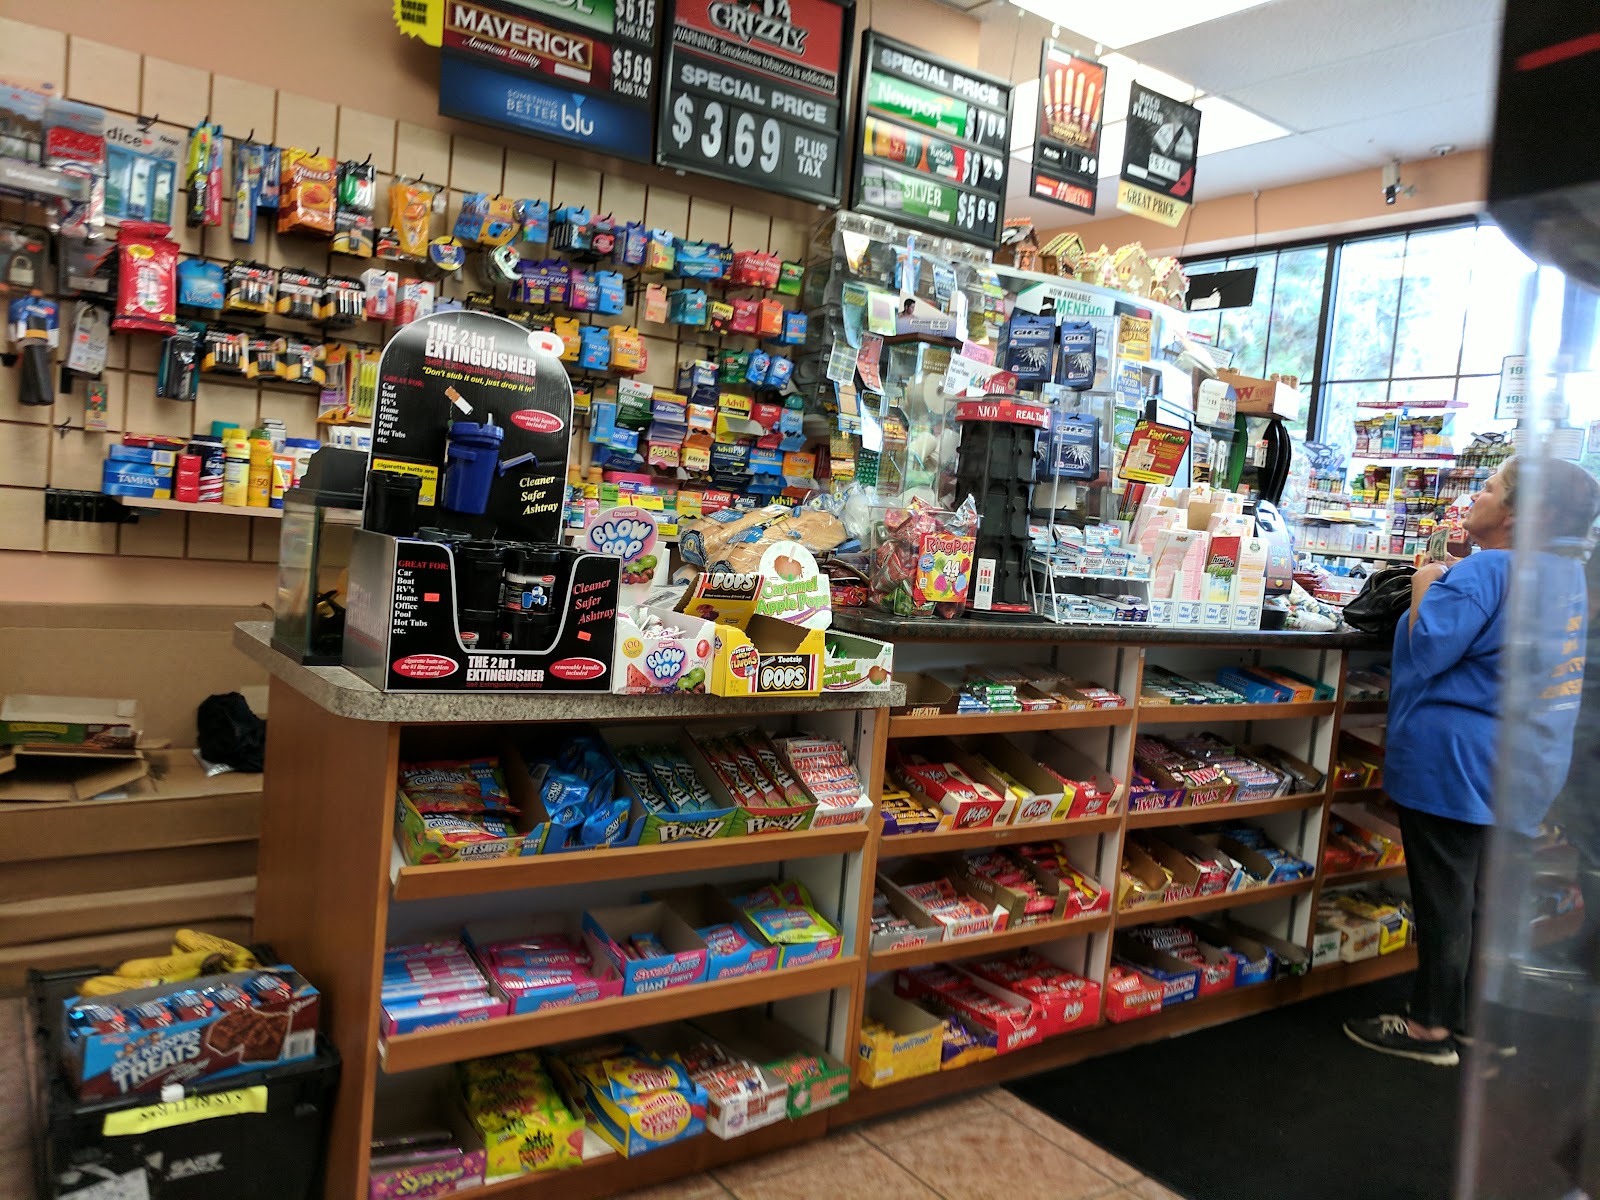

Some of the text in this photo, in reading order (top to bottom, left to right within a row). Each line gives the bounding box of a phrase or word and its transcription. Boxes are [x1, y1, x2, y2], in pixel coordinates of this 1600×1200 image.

[453, 5, 585, 64] MAVERICK
[616, 20, 651, 42] PLUS TAX
[709, 1, 808, 54] GRIZZLY
[462, 36, 541, 69] American Quality
[720, 40, 762, 66] Smokeless
[763, 56, 793, 77] tobacco
[881, 49, 999, 106] SPECIAL PRICE
[614, 78, 648, 99] PLUS TAX
[680, 64, 827, 125] SPECIAL PRICE
[507, 88, 558, 109] SOMETHING
[878, 81, 943, 120] Newport
[506, 98, 558, 120] BETTER
[561, 104, 594, 136] blu
[106, 126, 142, 147] dice
[794, 135, 828, 161] PLUS
[798, 155, 823, 178] TAX
[904, 180, 942, 207] SILVER
[1126, 188, 1175, 218] GREAT PRICE
[1050, 287, 1092, 302] NOW AVAILABLE
[427, 321, 457, 344] THE
[459, 329, 470, 345] 2
[471, 332, 487, 350] in
[425, 339, 536, 377] EXTINGUISHER
[382, 382, 395, 391] Car
[446, 370, 463, 380] stub
[464, 373, 469, 382] it
[470, 375, 484, 386] out,
[484, 377, 500, 387] just
[501, 380, 516, 391] drop
[518, 382, 524, 391] it
[382, 390, 397, 399] Boat
[725, 398, 745, 408] Advil
[379, 413, 398, 422] Office
[380, 405, 399, 415] Home
[977, 405, 1000, 418] NJOY
[1016, 410, 1035, 420] REAL
[379, 421, 393, 429] Pool
[378, 429, 406, 439] Hot Tubs
[377, 462, 406, 472] cigarette
[406, 466, 423, 474] butts
[117, 474, 159, 487] TAMPAX
[519, 475, 555, 488] Cleaner
[521, 491, 546, 505] Safer
[769, 496, 793, 506] Advil
[523, 502, 558, 515] Ashtray
[591, 519, 653, 546] BLOW
[601, 540, 643, 560] POP
[397, 569, 413, 577] Car
[398, 560, 449, 570] GREAT FOR:
[943, 560, 960, 576] 44
[1206, 564, 1234, 582] Play
[396, 585, 415, 594] RV's
[397, 577, 415, 585] Boat
[572, 578, 611, 595] Cleaner
[712, 573, 755, 591] POPS
[762, 576, 818, 598] Caramel
[396, 593, 418, 601] Home
[575, 595, 602, 611] Safer
[756, 592, 831, 616] Apple Pops
[394, 610, 411, 618] Pool
[395, 602, 418, 610] Office
[394, 618, 428, 627] Hot Tubs
[577, 608, 615, 625] Ashtray
[393, 627, 406, 635] etc.
[623, 640, 640, 650] 100
[468, 656, 515, 669] THE 2 in 1
[646, 648, 685, 669] BLOW
[778, 656, 802, 664] Tootsie
[466, 669, 545, 682] EXTINGUISHER
[654, 663, 681, 680] POP
[761, 666, 806, 688] POPS
[911, 707, 941, 717] HEATH
[793, 753, 844, 771] PAYDAY
[801, 766, 853, 784] PAYDAY
[746, 814, 806, 835] PUNCH
[815, 811, 863, 827] PAYDAY
[658, 821, 726, 843] PUNCH
[636, 976, 669, 994] GIANT
[115, 1044, 200, 1093] TREATS
